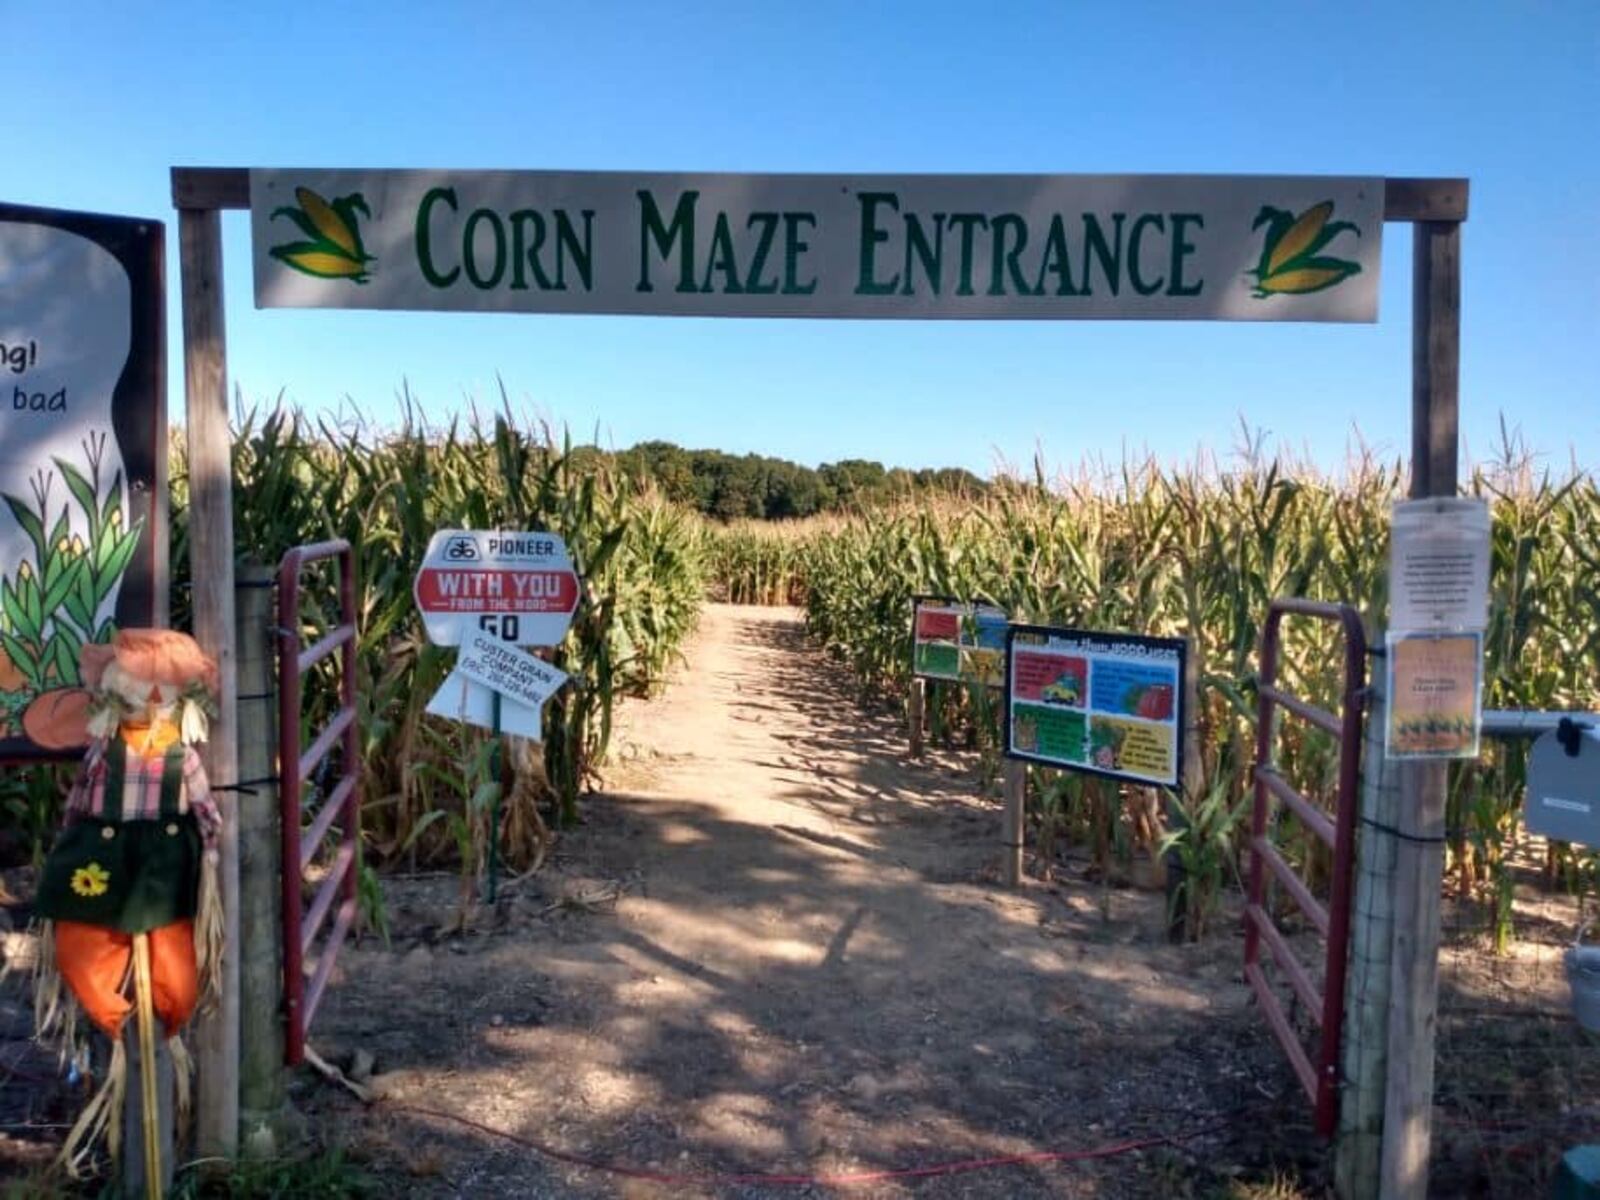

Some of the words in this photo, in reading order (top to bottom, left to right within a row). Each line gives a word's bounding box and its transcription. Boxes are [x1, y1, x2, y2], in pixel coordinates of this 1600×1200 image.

[415, 187, 595, 291] CORN
[635, 190, 818, 294] MAZE
[855, 192, 1204, 297] ENTRANCE
[13, 386, 67, 413] bad
[489, 538, 554, 556] PIONEER
[437, 573, 503, 597] WITH
[512, 574, 561, 597] YOU
[450, 599, 484, 610] FROM
[489, 599, 510, 610] THE
[479, 614, 519, 641] GO
[474, 638, 518, 665] CUSTER
[519, 660, 552, 683] GRAIN
[481, 654, 534, 685] COMPANY
